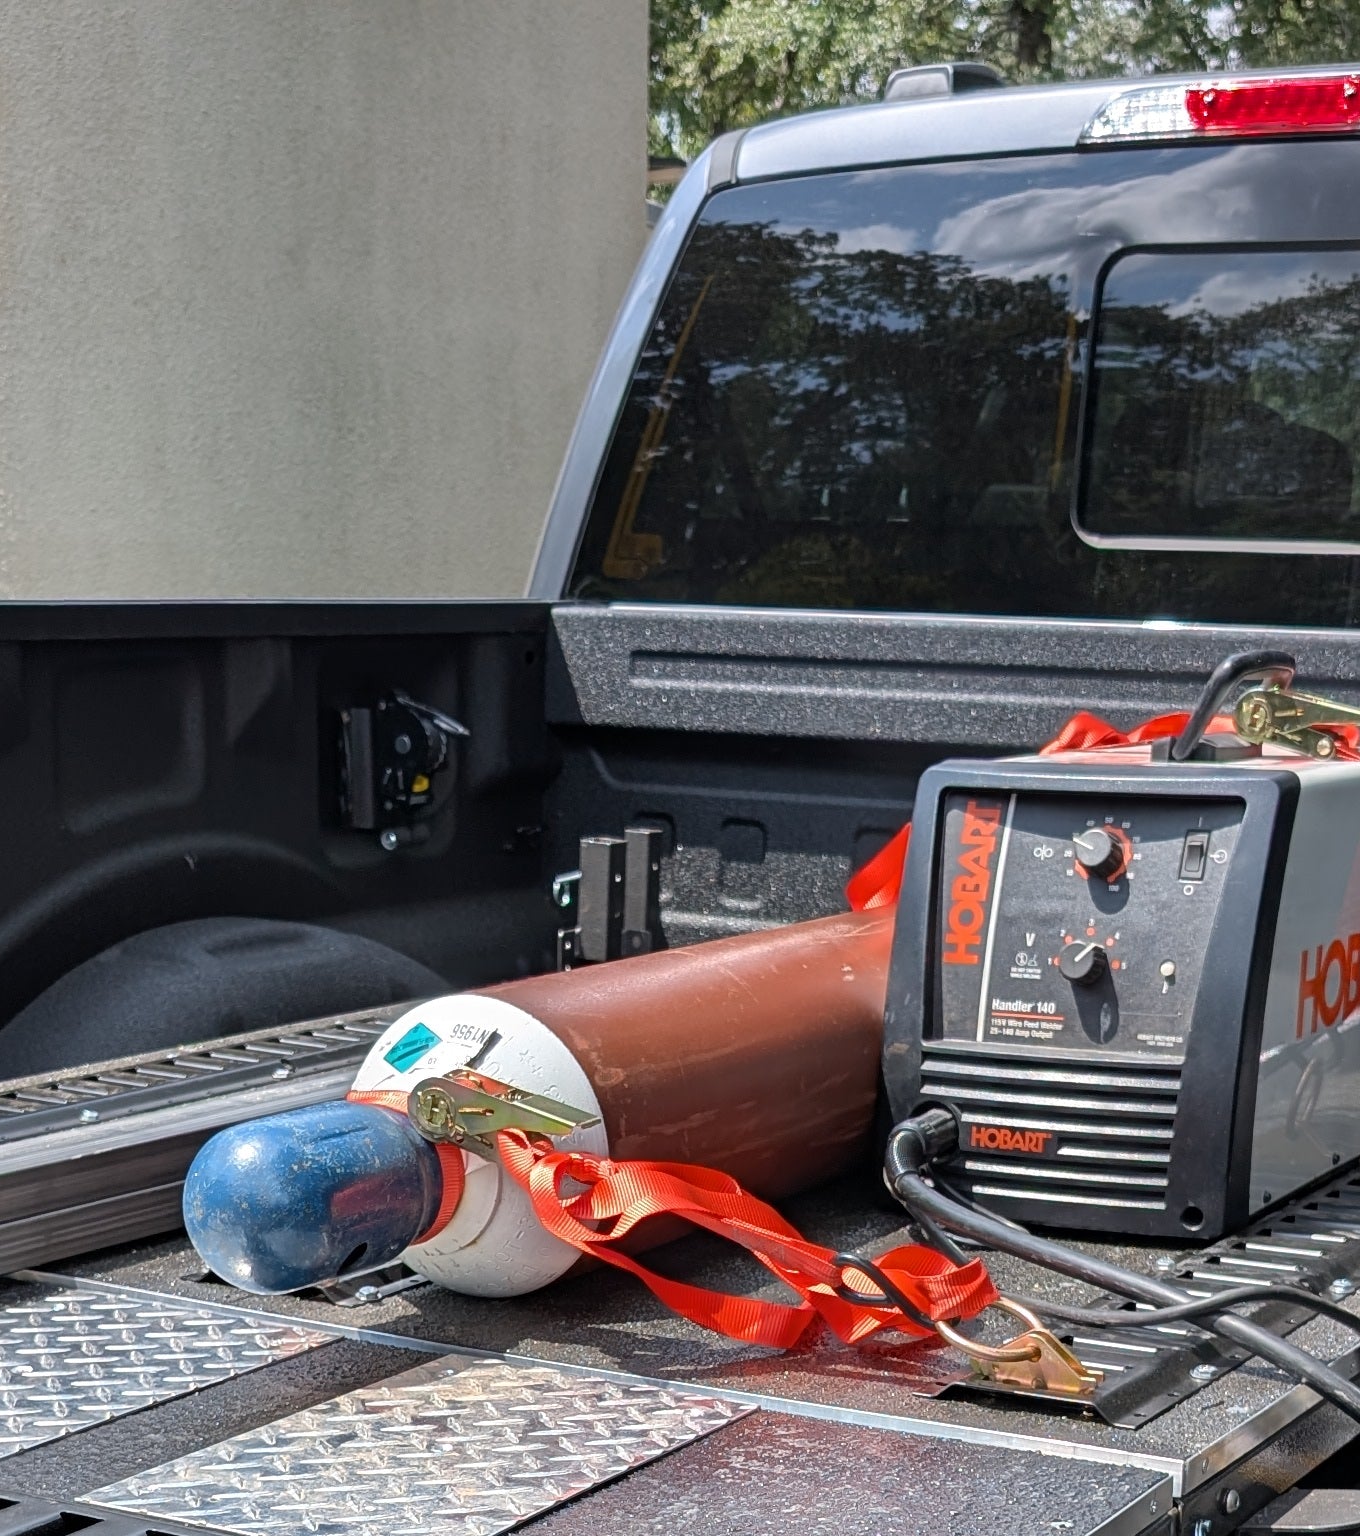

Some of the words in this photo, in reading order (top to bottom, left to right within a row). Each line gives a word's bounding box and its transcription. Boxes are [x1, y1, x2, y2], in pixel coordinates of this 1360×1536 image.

[943, 801, 1002, 964] HOBART
[1026, 933, 1036, 946] V
[992, 999, 1032, 1012] Handler
[1037, 1001, 1056, 1014] 140
[450, 1024, 489, 1044] N1956
[970, 1126, 1046, 1153] HOBART
